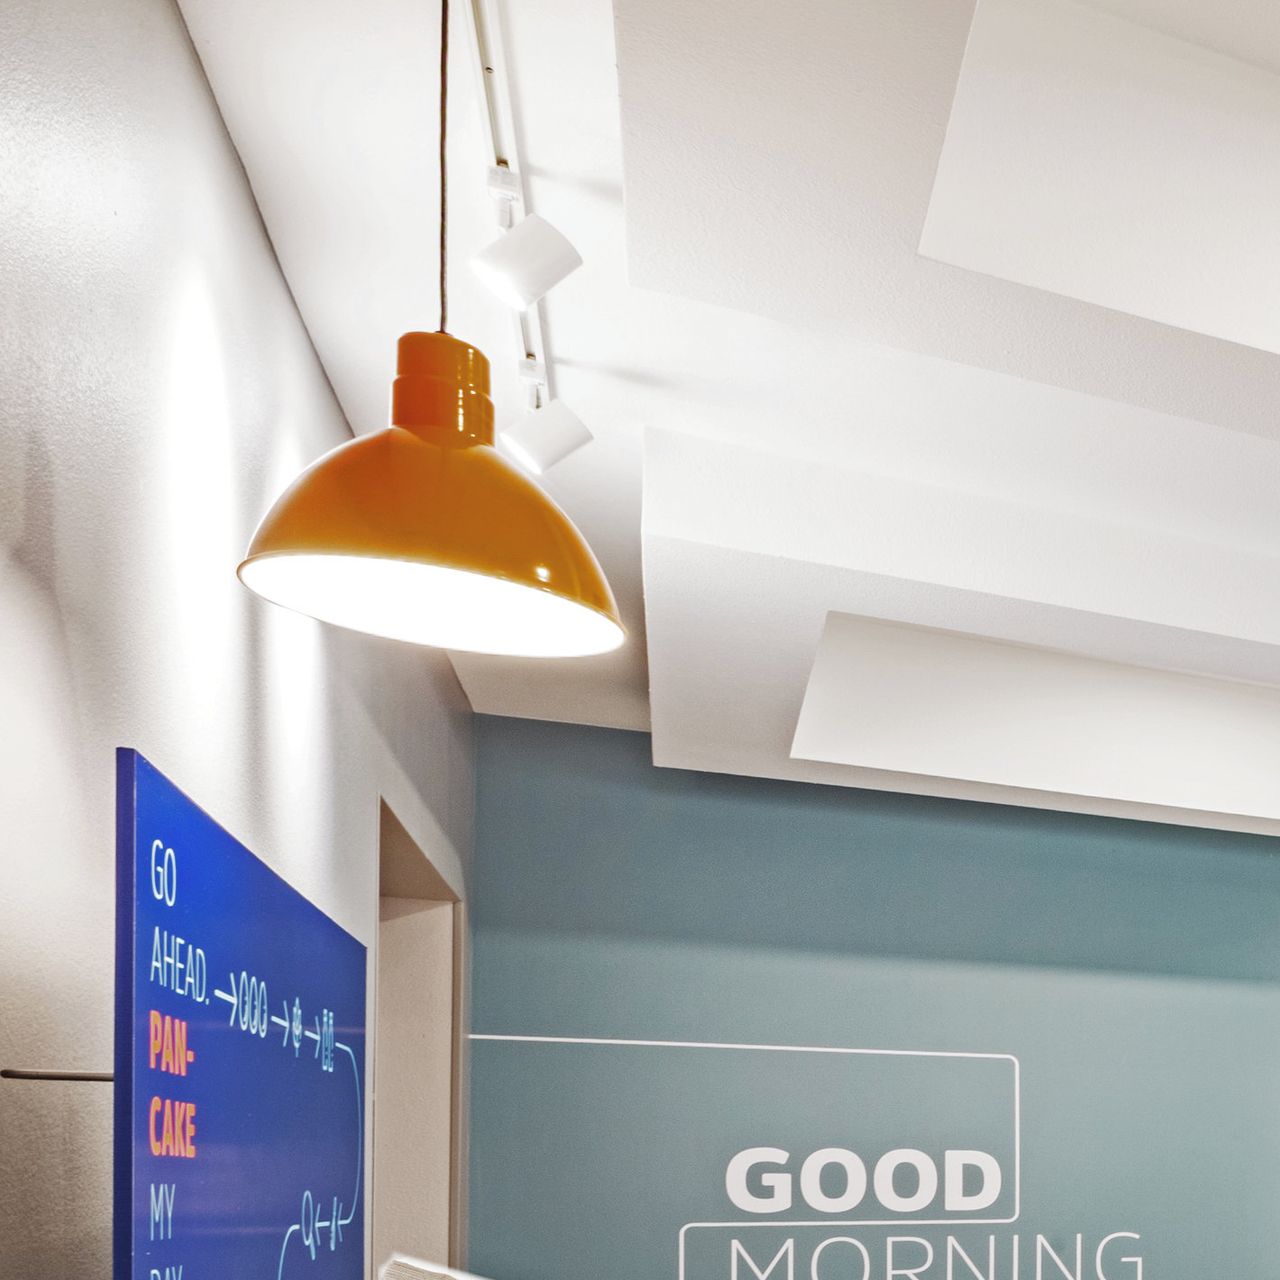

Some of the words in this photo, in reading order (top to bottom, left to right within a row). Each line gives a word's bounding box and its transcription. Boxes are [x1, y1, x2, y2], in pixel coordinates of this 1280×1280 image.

[151, 839, 177, 907] GO
[150, 926, 210, 1005] AHEAD.
[149, 1010, 194, 1076] PAN-
[149, 1096, 196, 1158] CAKE
[150, 1184, 176, 1241] MY
[725, 1147, 1002, 1213] GOOD
